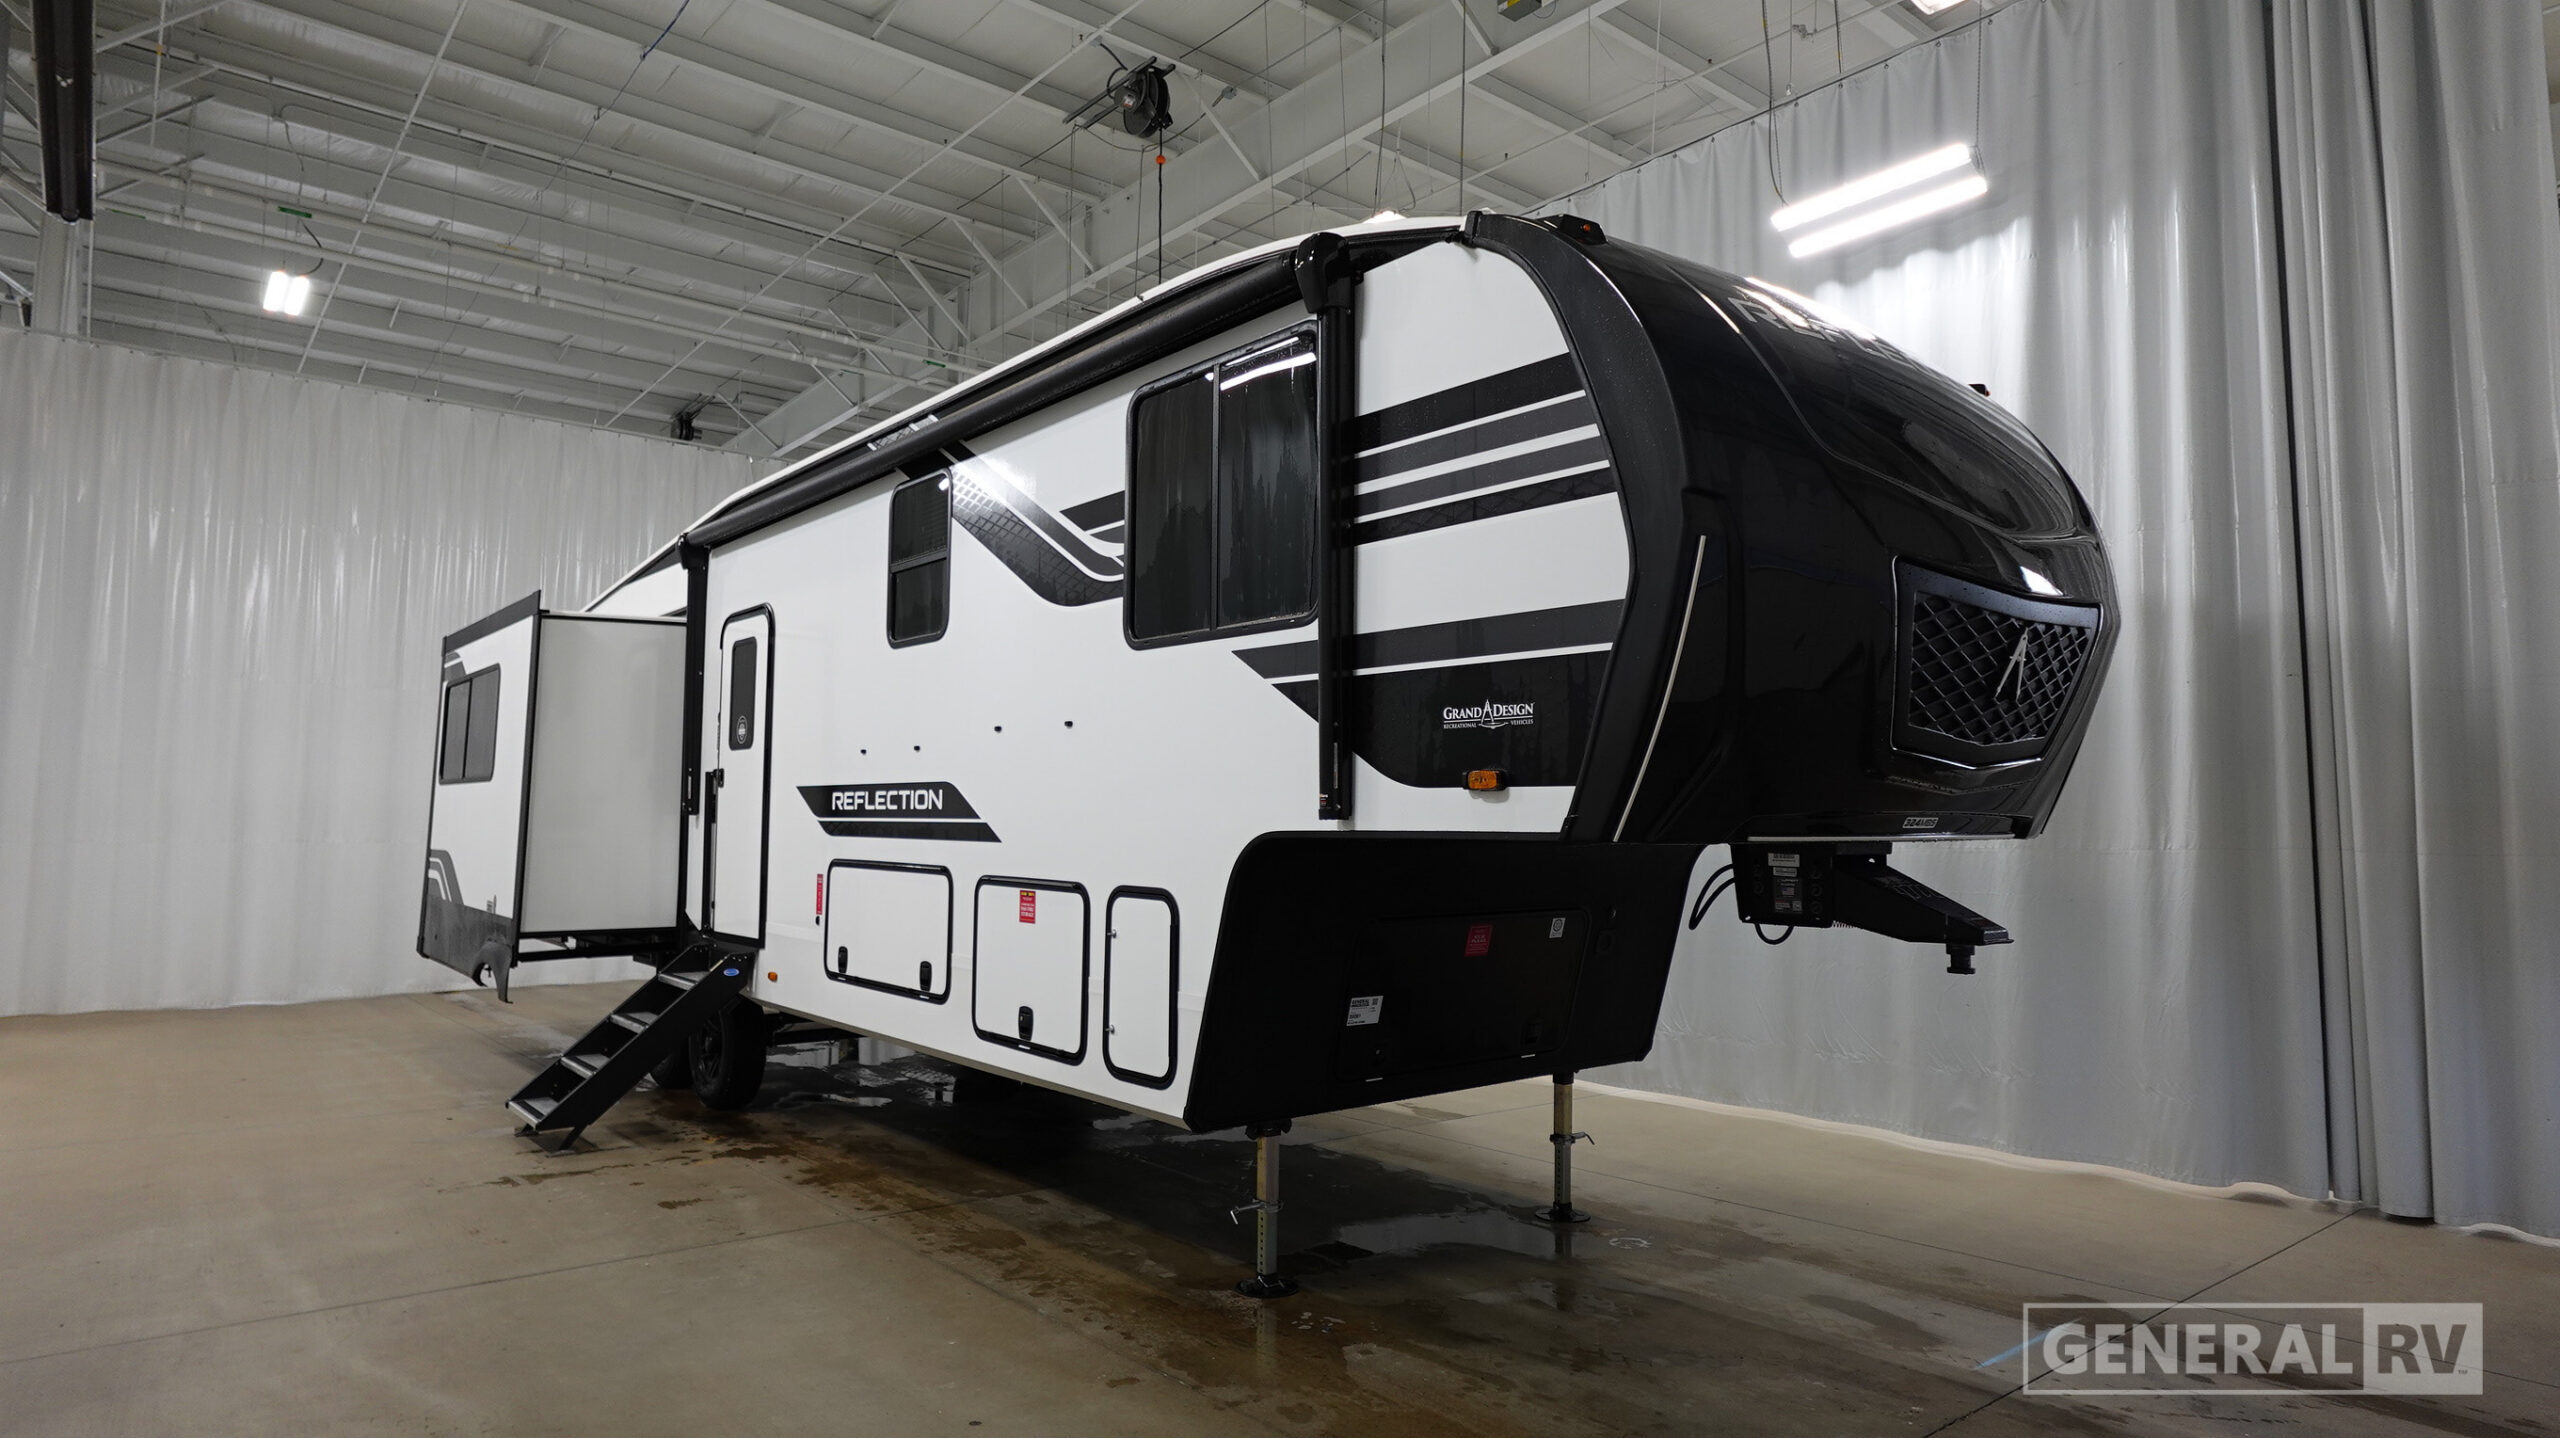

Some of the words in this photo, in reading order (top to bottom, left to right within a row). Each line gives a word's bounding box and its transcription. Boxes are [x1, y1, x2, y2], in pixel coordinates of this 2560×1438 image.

[1443, 706, 1483, 720] GRAND
[1493, 703, 1534, 717] DESIGN
[832, 789, 943, 810] REFLECTION
